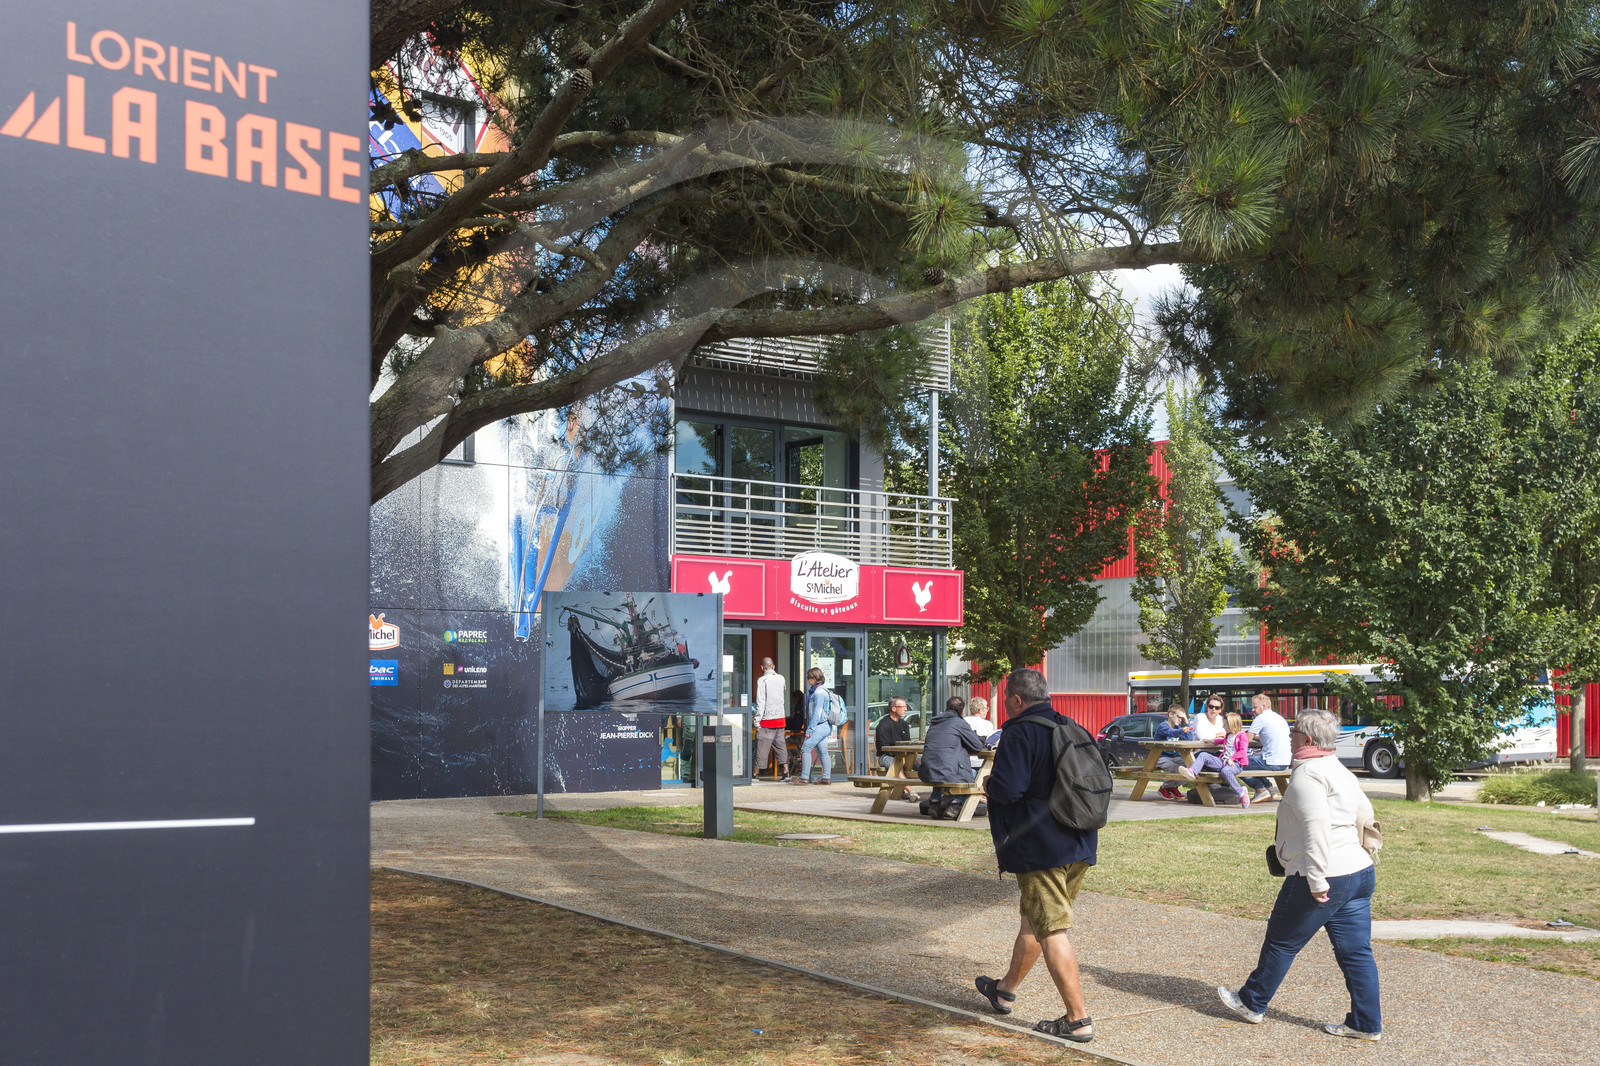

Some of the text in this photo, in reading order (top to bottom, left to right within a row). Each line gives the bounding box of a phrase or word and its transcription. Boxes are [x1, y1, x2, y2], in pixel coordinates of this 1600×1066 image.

[67, 21, 278, 104] LORIENT
[66, 74, 157, 164] LA
[185, 99, 361, 204] BASE
[797, 560, 853, 578] L'Atelier
[790, 597, 819, 614] Biscuits
[830, 601, 859, 616] gâteaux
[458, 630, 488, 639] PAPREC
[600, 731, 638, 739] JEAN-PIERRE
[639, 731, 654, 739] DICK
